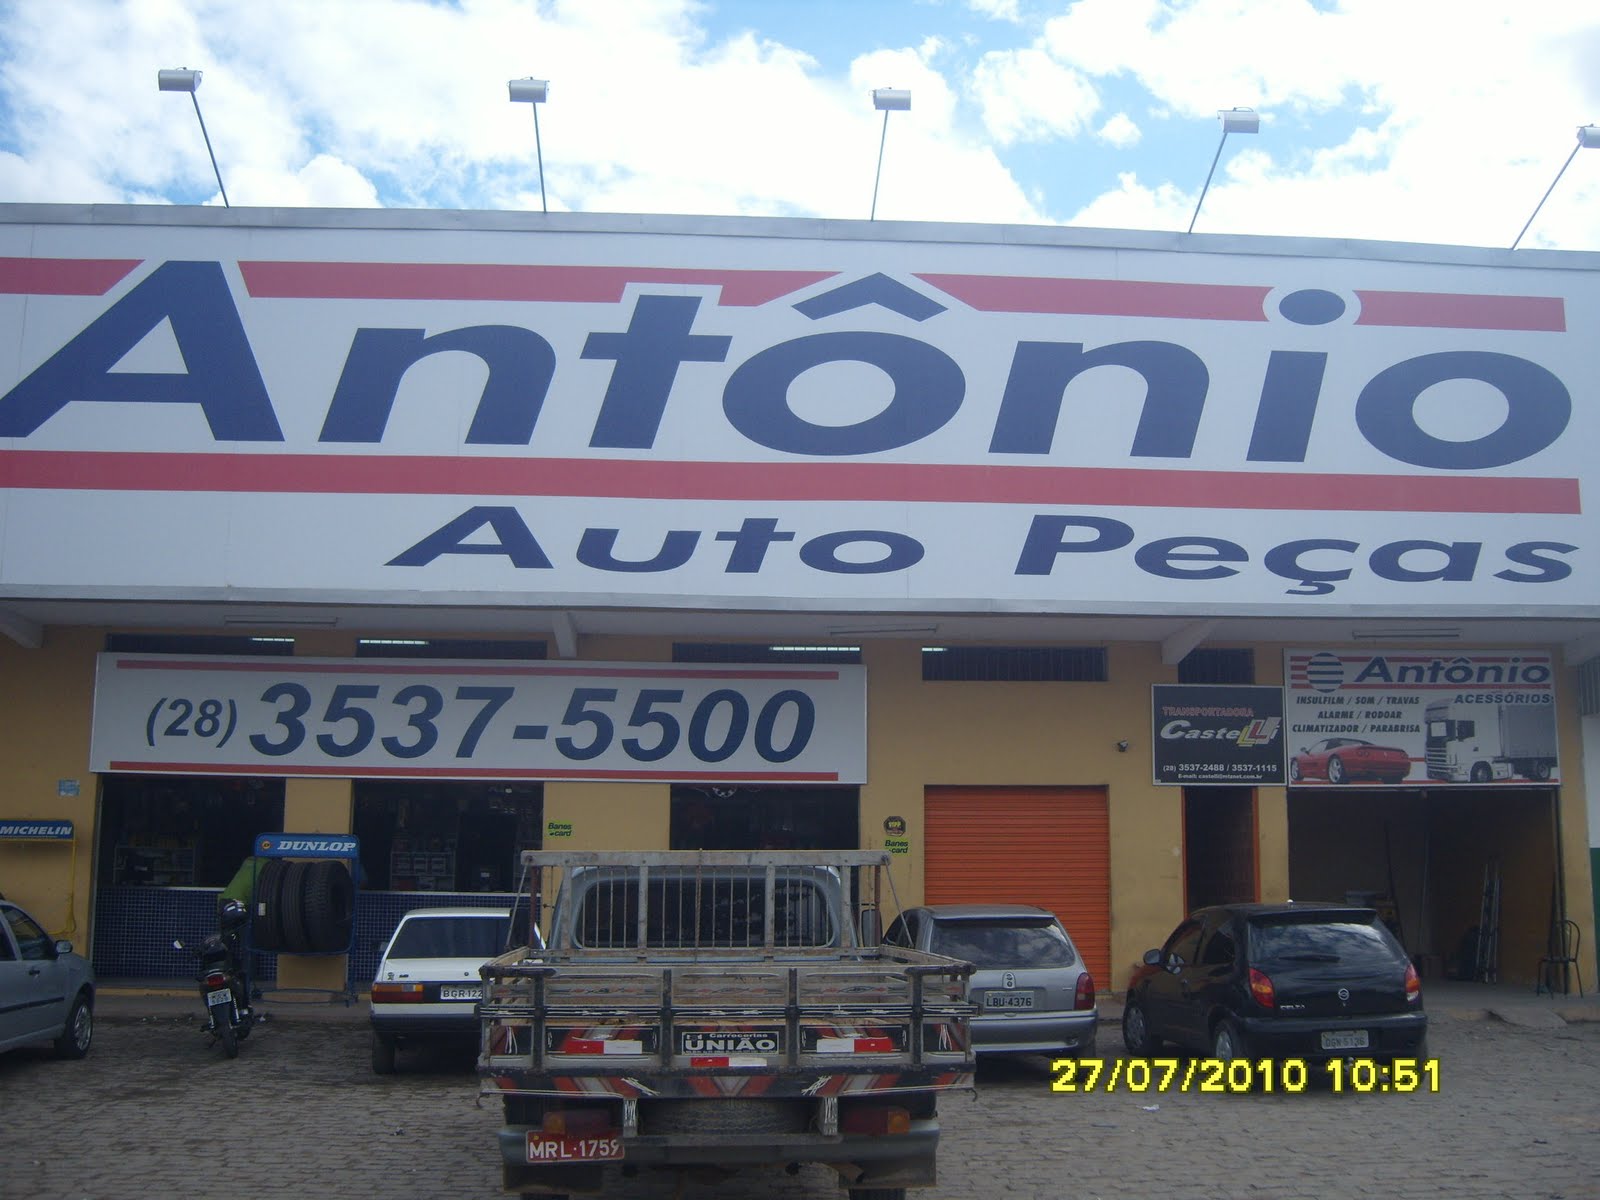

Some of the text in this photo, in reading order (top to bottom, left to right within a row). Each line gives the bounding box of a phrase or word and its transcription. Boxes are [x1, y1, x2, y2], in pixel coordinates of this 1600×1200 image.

[0, 260, 1572, 470] Antônio
[382, 506, 1581, 595] Auto Peças
[1353, 656, 1550, 683] Antônio
[1296, 696, 1344, 705] INSULFILM
[1355, 696, 1375, 705] SOM
[1386, 696, 1420, 705] TRAVAS
[1454, 692, 1550, 704] ACESSÓRIOS
[1317, 711, 1354, 719] ALARME
[1365, 711, 1402, 719] RODOAR
[145, 682, 816, 763] (28) 3537-5500
[1292, 724, 1359, 733] CLIMATIZADOR
[1370, 724, 1420, 733] PARABRISA
[1231, 764, 1278, 772] 3537-1115
[0, 826, 73, 835] MICHELIN
[277, 841, 357, 851] DUNLOP
[685, 1037, 776, 1051] UNIÃO
